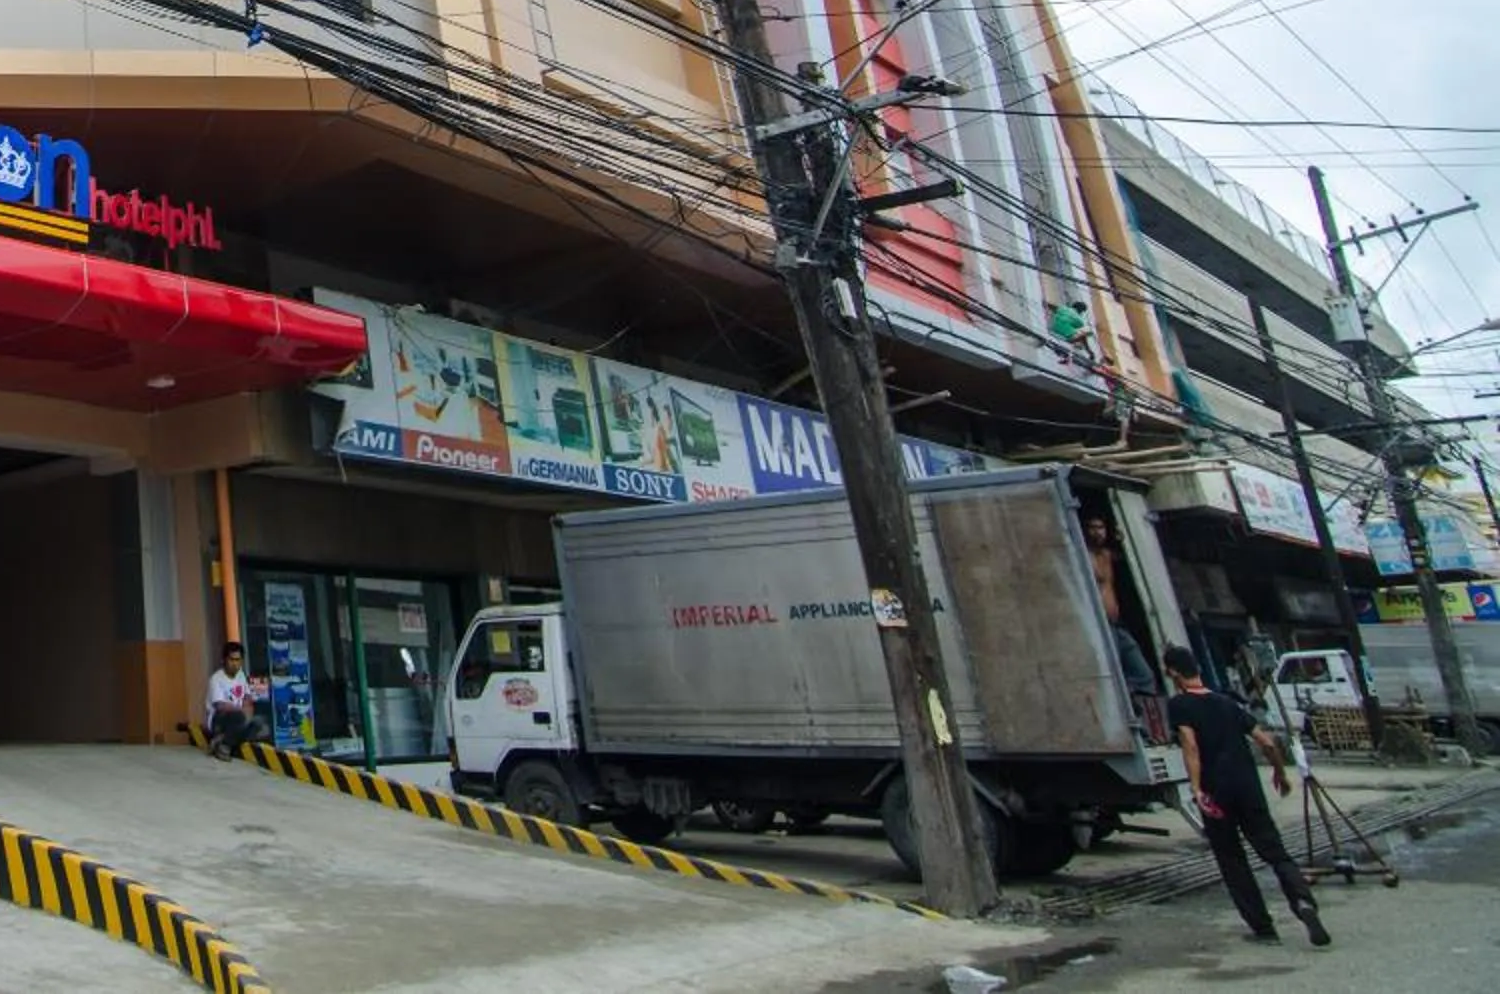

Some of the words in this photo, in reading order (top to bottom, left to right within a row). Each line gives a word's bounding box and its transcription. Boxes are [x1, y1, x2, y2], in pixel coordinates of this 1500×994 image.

[417, 434, 499, 471] Pioneer
[748, 404, 928, 485] MADN
[615, 470, 675, 498] SONY
[672, 605, 778, 629] IMPERIAL
[789, 600, 874, 620] APPLIANC
